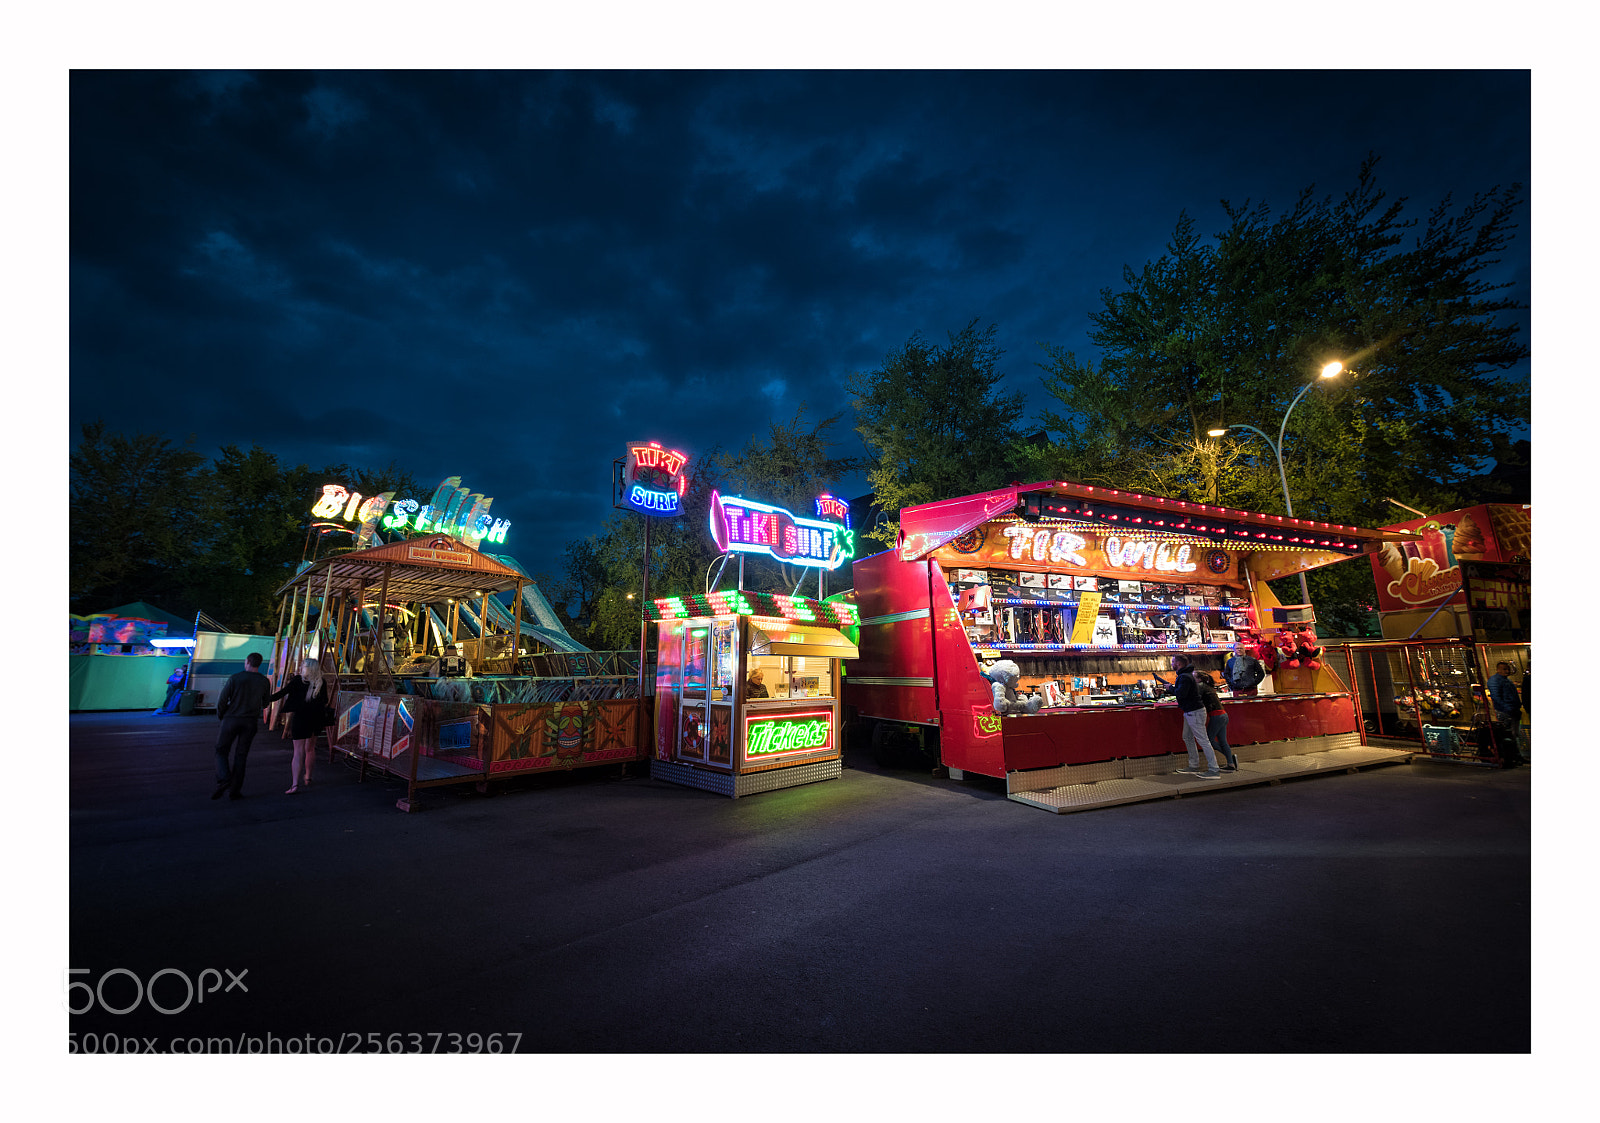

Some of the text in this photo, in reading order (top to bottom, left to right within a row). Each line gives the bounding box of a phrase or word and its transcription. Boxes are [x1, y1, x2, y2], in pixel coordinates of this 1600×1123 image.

[632, 447, 682, 475] TIKI
[631, 485, 678, 510] SURF
[820, 499, 847, 518] TIKI
[785, 525, 833, 558] SURF
[1003, 526, 1197, 573] TIR WILL
